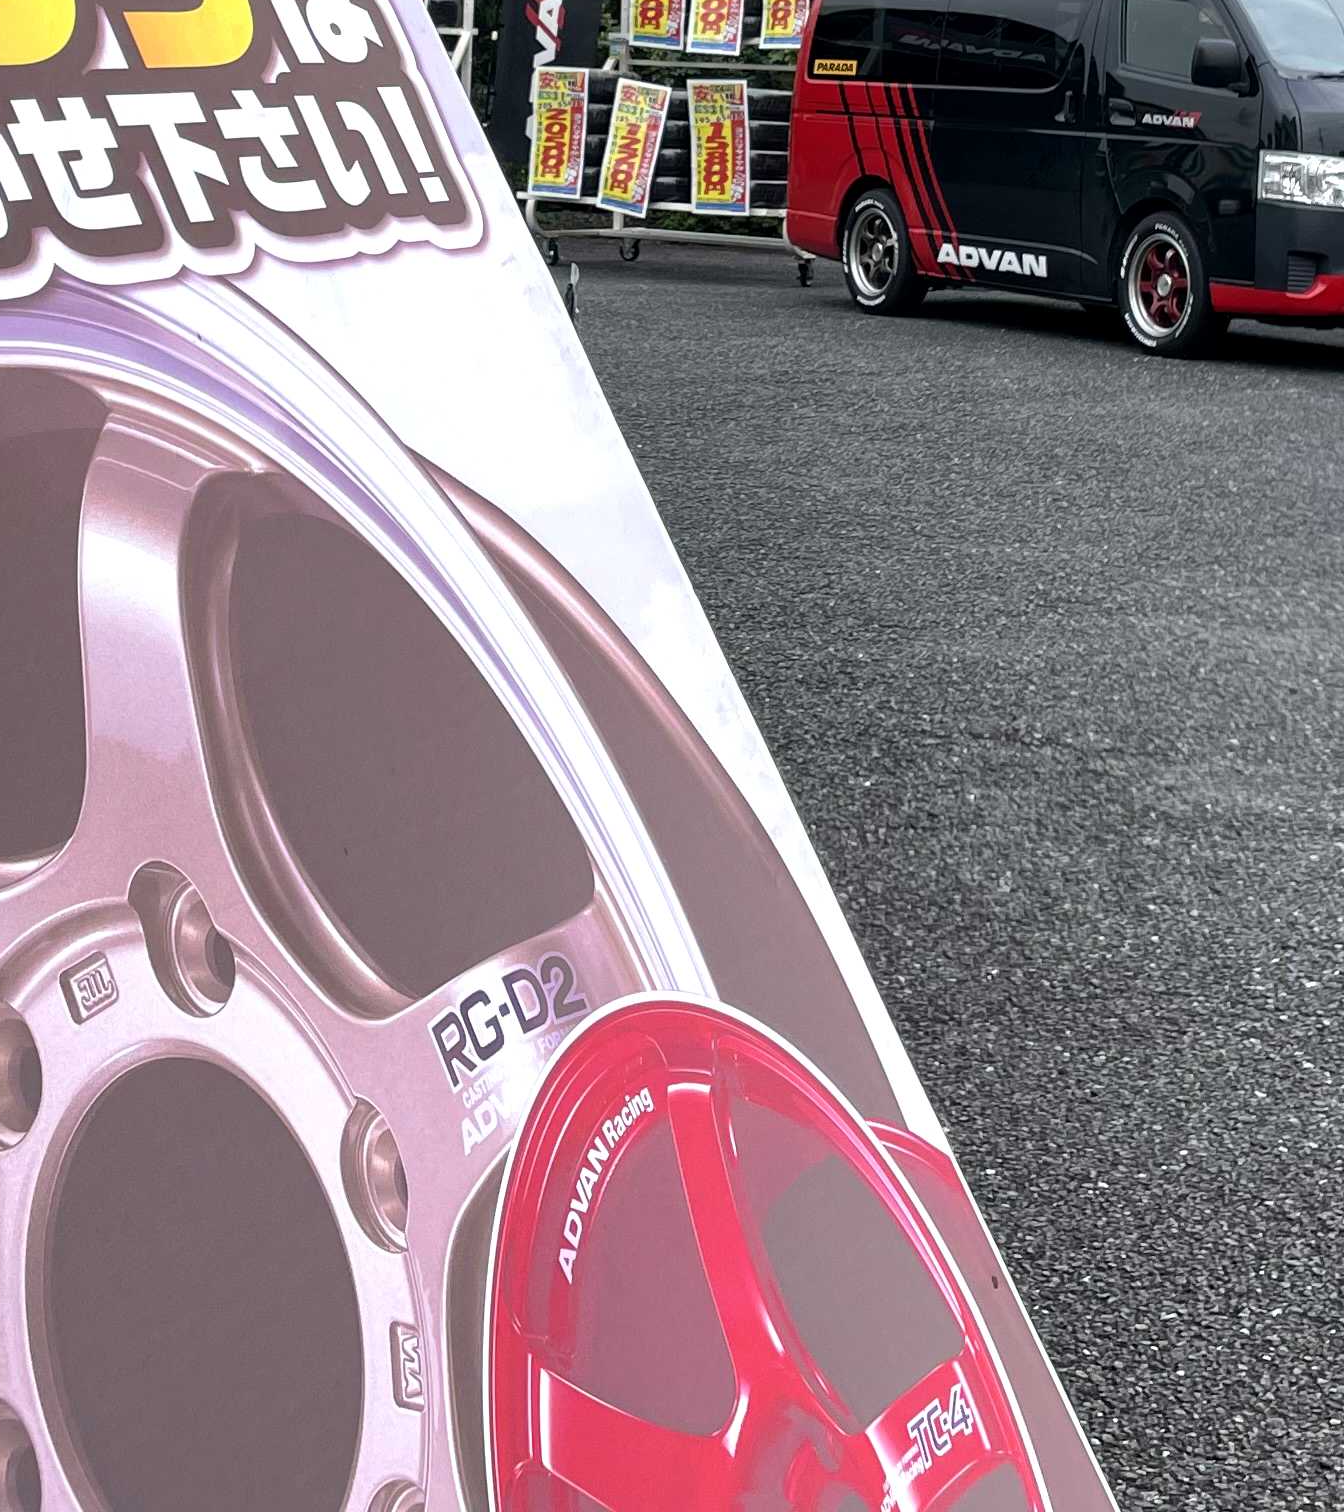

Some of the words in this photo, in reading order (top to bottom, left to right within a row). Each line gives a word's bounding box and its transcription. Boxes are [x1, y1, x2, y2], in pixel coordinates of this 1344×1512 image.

[816, 62, 854, 73] PARADA
[1141, 112, 1195, 129] ADVAN
[936, 243, 1048, 278] ADVAN
[559, 1136, 609, 1285] ADVAN
[601, 1088, 655, 1149] Racing
